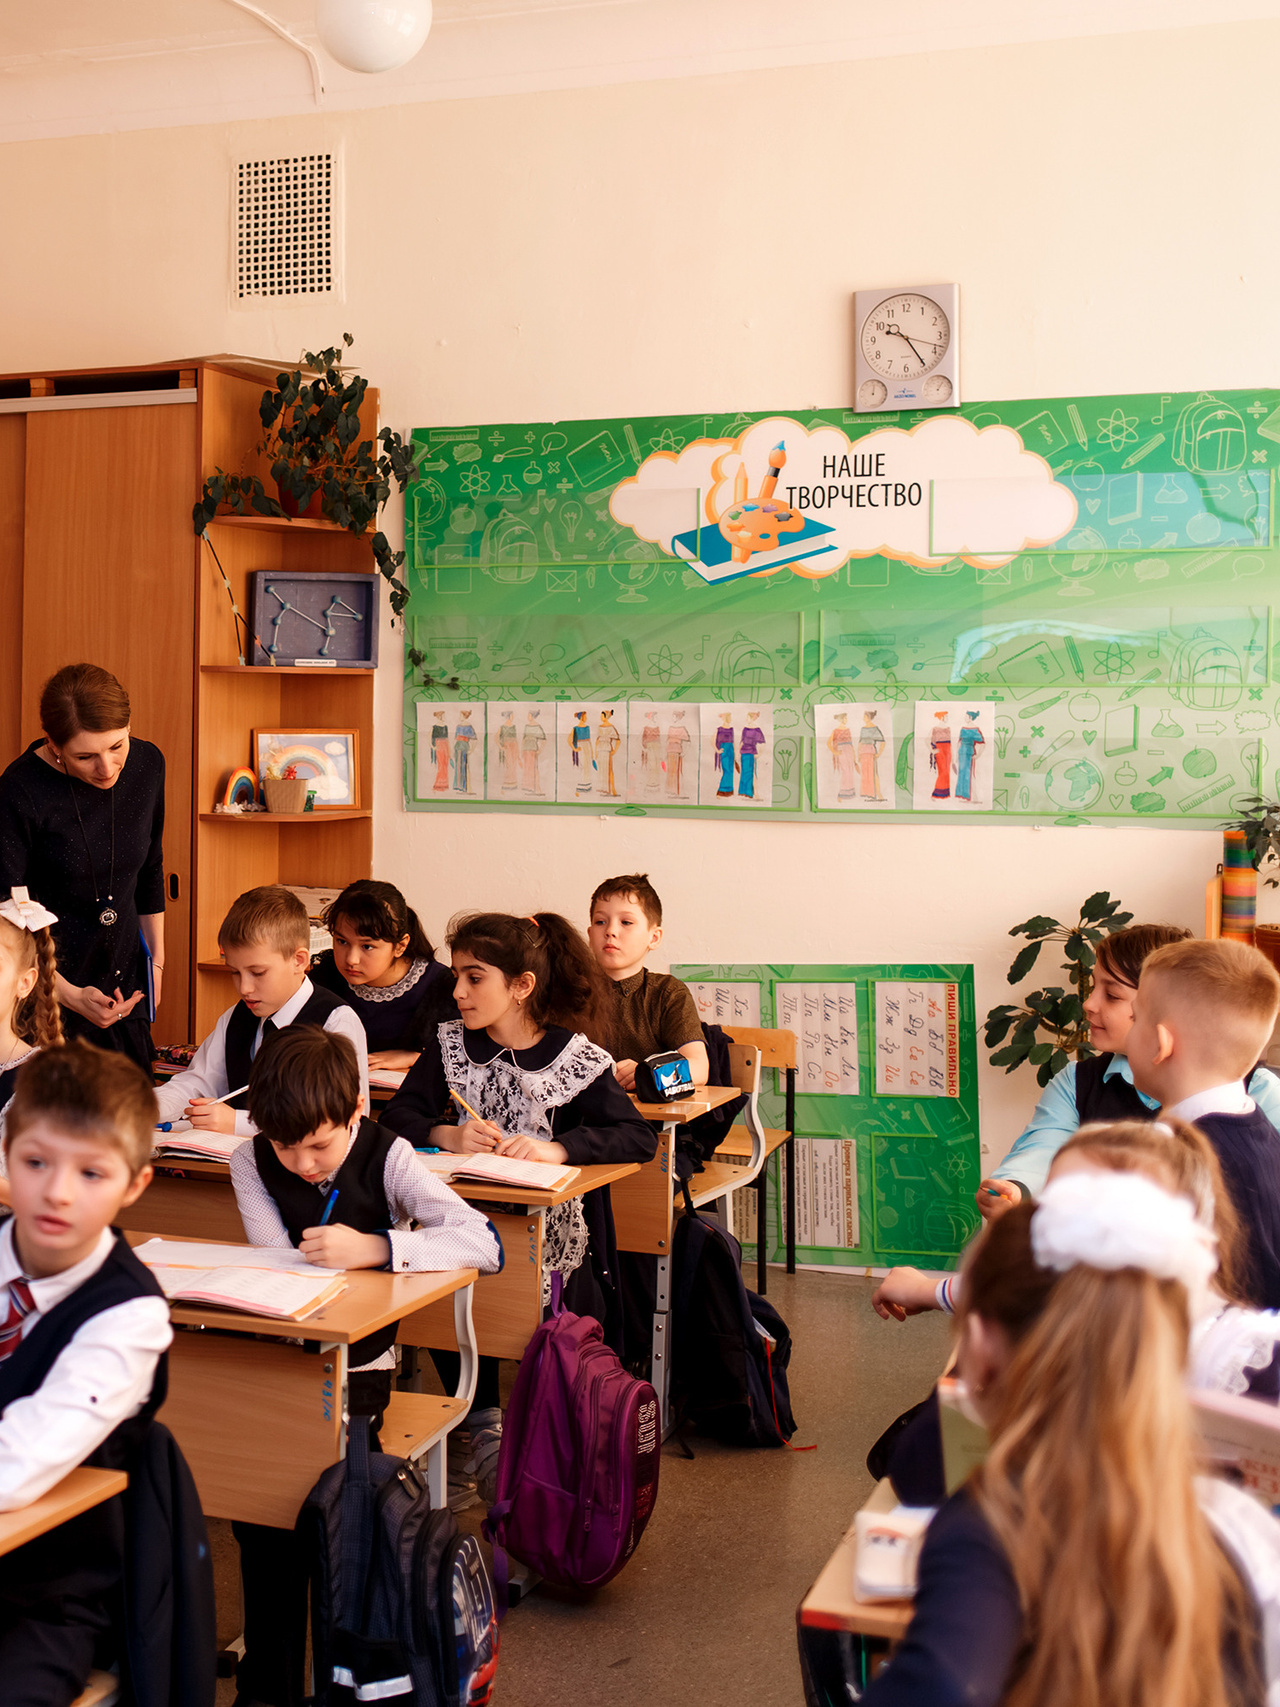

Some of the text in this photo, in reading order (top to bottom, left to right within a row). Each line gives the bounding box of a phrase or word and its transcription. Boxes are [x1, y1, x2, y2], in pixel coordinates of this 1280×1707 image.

[902, 303, 911, 312] 12
[921, 307, 924, 315] 1
[876, 322, 884, 330] 10
[932, 317, 937, 326] 2
[871, 336, 876, 345] 9
[937, 332, 942, 340] 3
[932, 344, 937, 355] 4
[888, 360, 892, 369] 7
[904, 364, 909, 373] 6
[823, 453, 886, 478] НАШЕ
[785, 482, 922, 510] ТВОРЧЕСТВО
[948, 984, 957, 1096] ПИШИ ПРАВИЛЬНО
[842, 1140, 852, 1176] Проверка
[843, 1178, 852, 1206] парных
